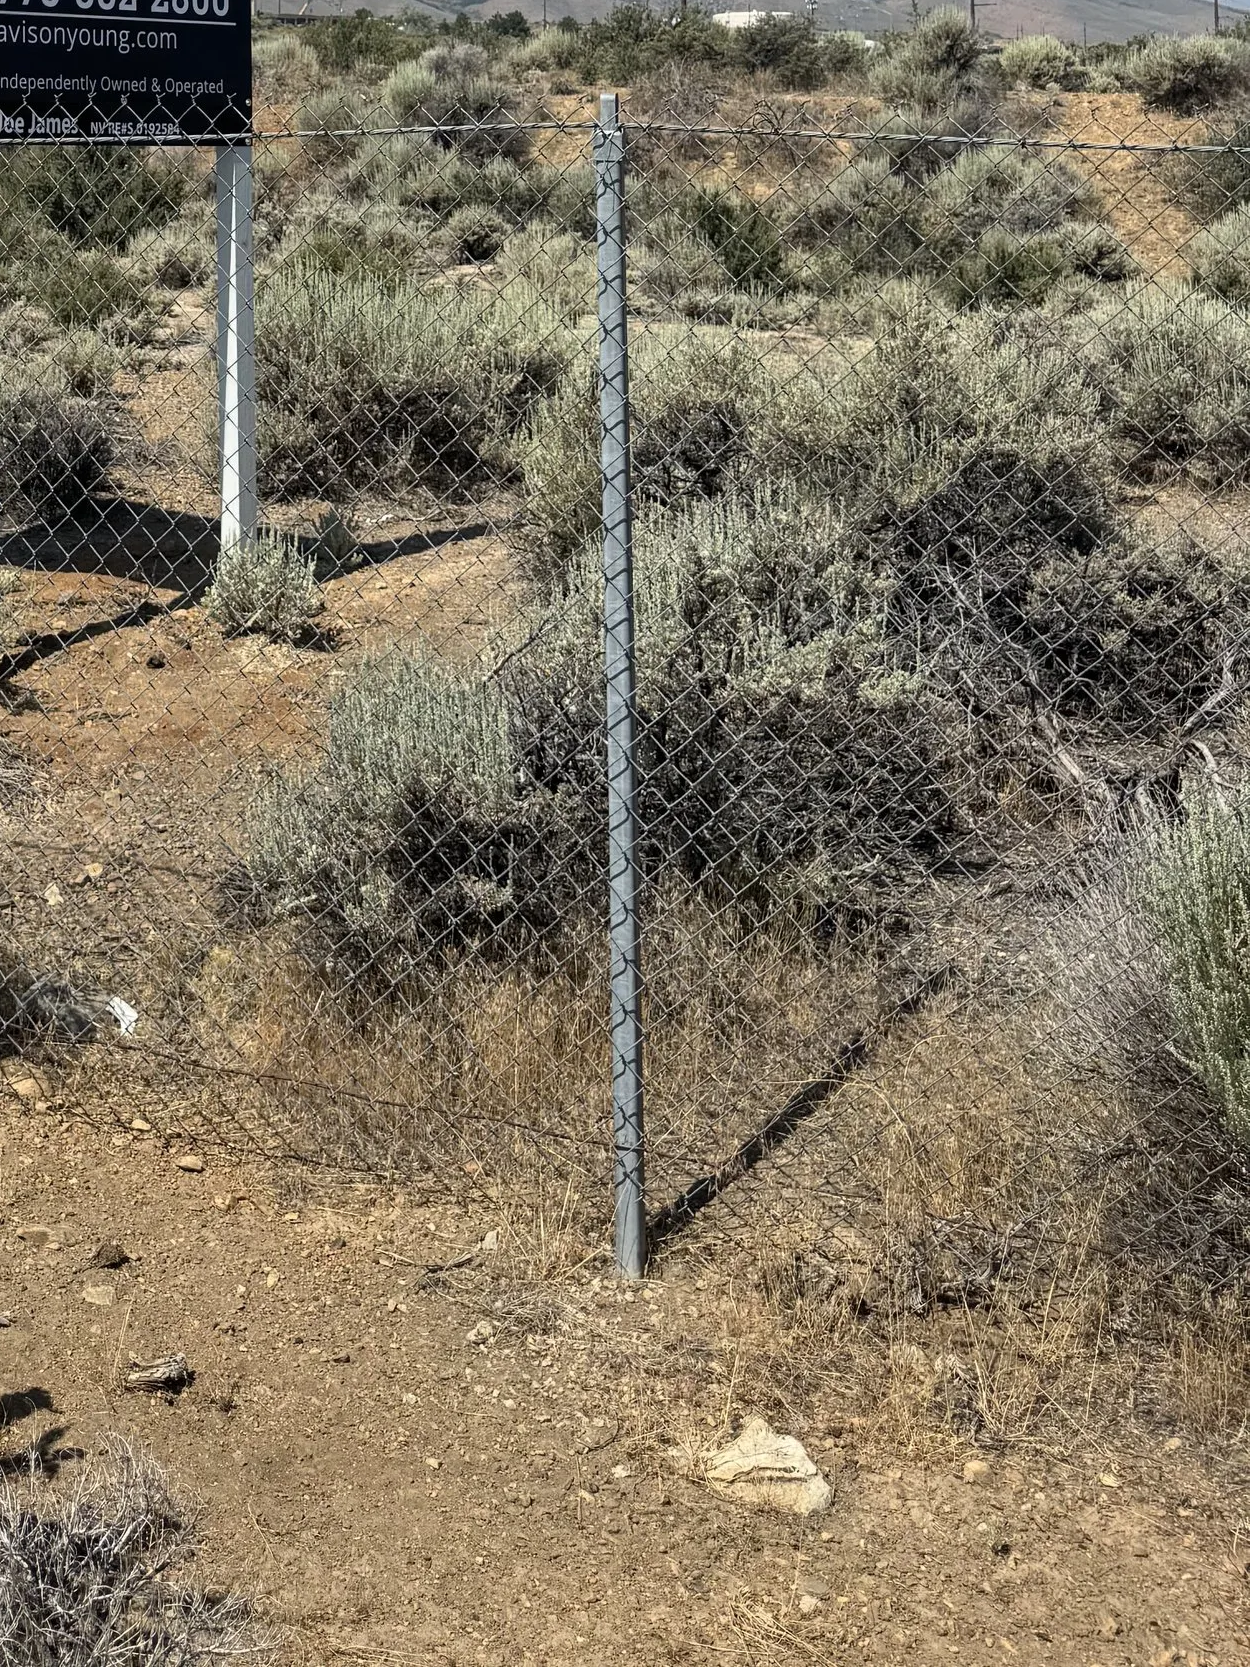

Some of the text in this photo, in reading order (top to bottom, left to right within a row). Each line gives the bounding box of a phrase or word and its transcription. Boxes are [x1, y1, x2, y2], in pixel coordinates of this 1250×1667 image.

[101, 76, 147, 93] Owned
[151, 77, 161, 92] &
[165, 78, 224, 97] Operated
[28, 114, 79, 135] James
[90, 121, 106, 135] NV
